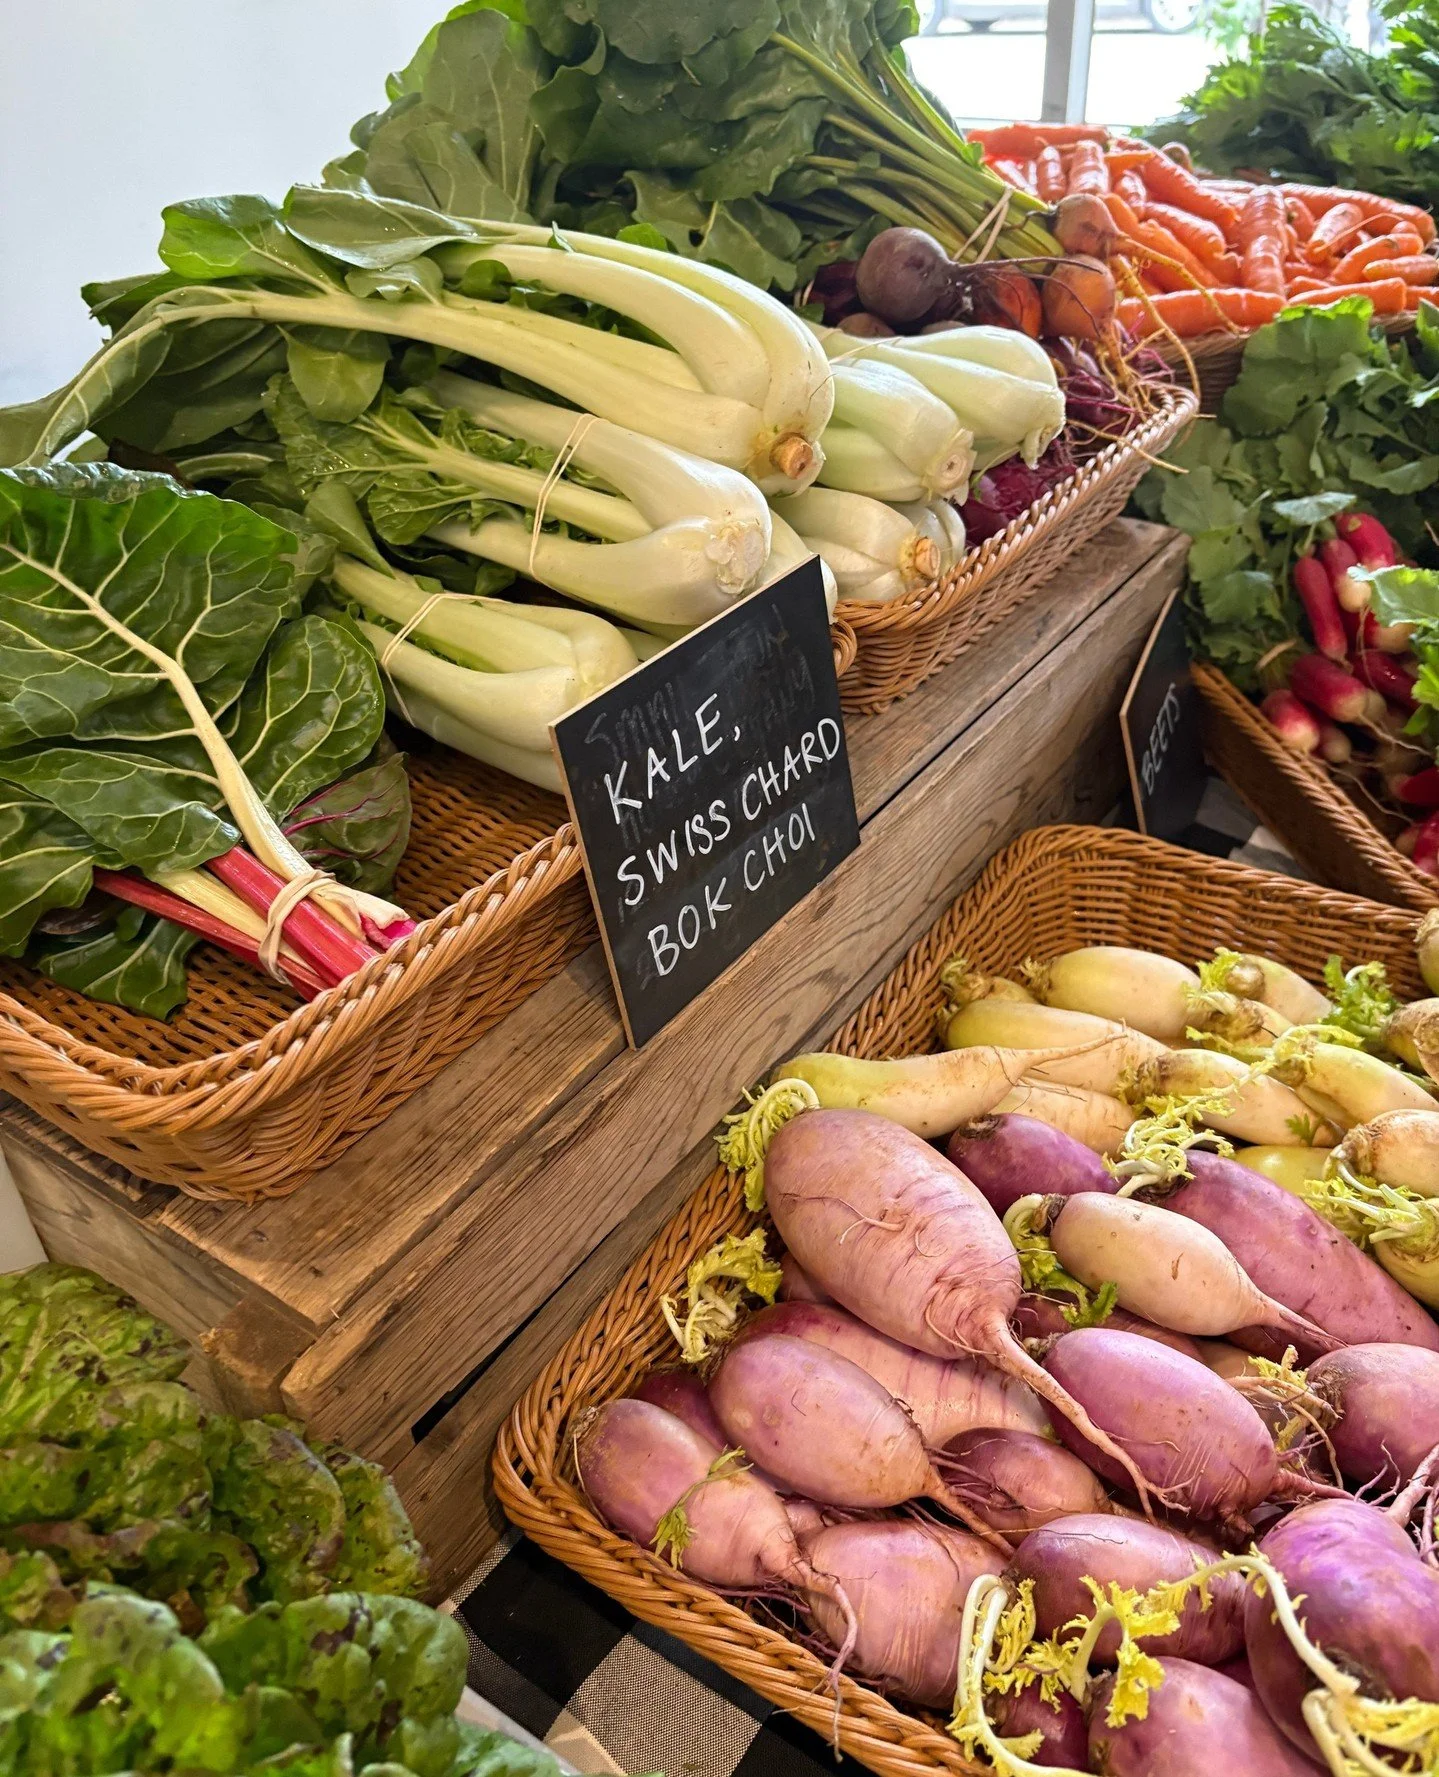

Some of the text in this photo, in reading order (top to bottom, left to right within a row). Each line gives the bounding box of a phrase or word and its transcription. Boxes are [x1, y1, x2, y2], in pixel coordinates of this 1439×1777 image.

[605, 692, 742, 824] KALE,
[617, 799, 732, 906] SWISS
[742, 717, 841, 822] CHARD
[1141, 682, 1181, 796] BEETS
[647, 802, 816, 977] BOK CHOI
